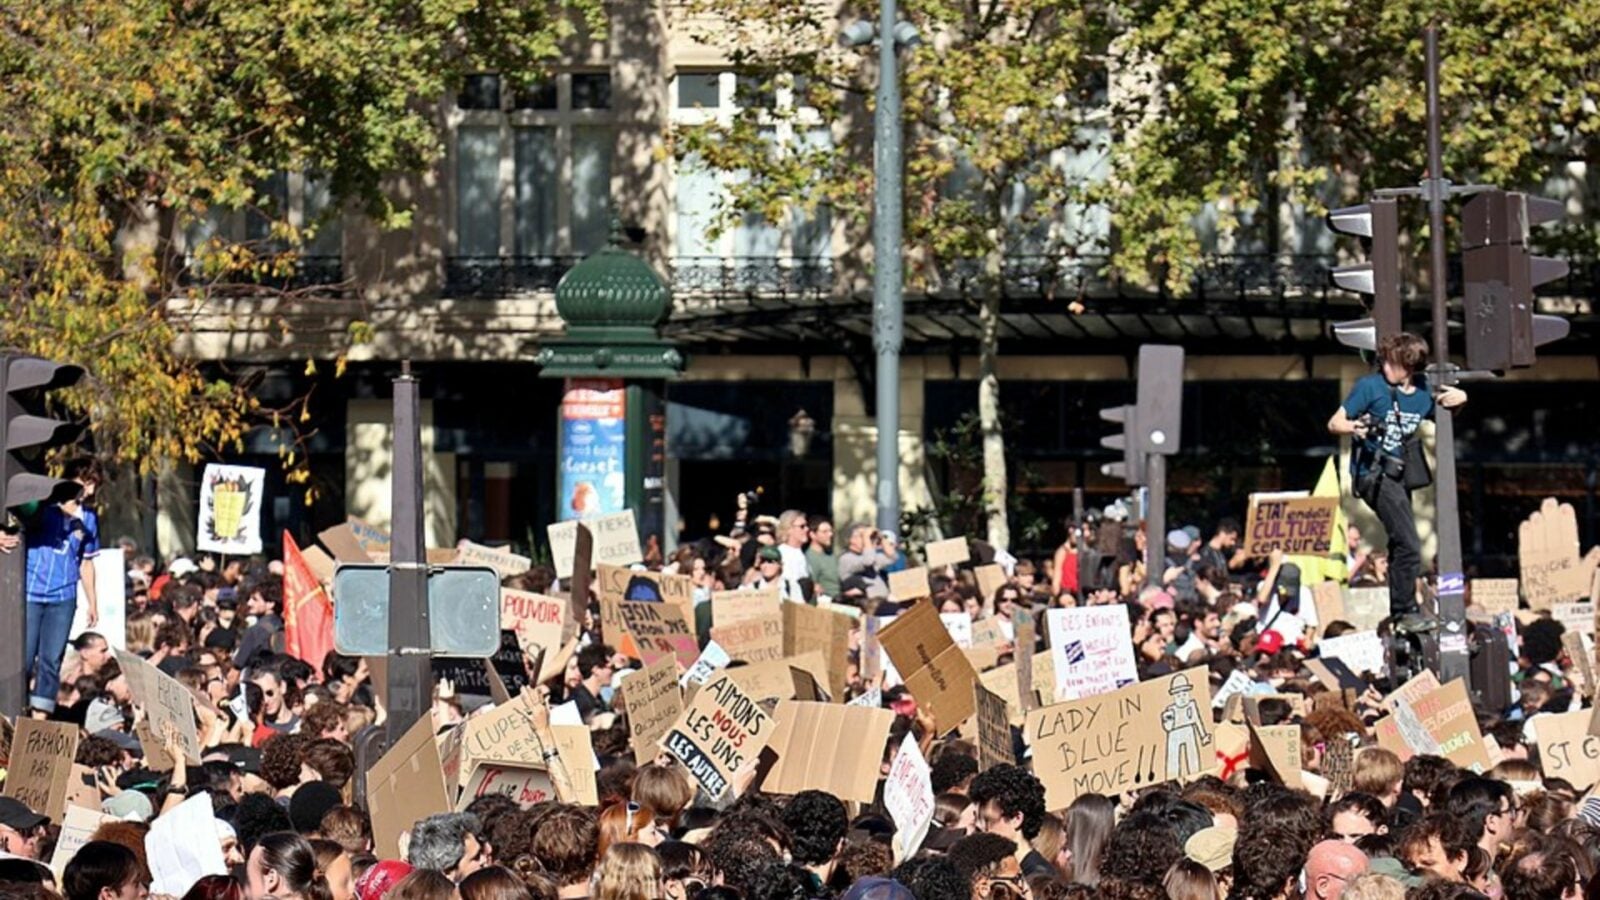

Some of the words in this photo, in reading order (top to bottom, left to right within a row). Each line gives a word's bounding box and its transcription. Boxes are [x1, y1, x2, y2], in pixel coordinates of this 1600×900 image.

[1253, 518, 1329, 540] CULTURE
[503, 595, 560, 624] POUVOIR
[705, 676, 765, 736] AIMONS
[1037, 702, 1102, 740] LADY
[1118, 694, 1142, 719] IN
[686, 707, 714, 742] LES
[711, 736, 744, 772] UNS
[712, 709, 747, 748] NOUS
[668, 733, 695, 760] LES
[1057, 721, 1129, 773] BLUE
[1547, 740, 1571, 770] ST
[29, 759, 49, 778] PAS
